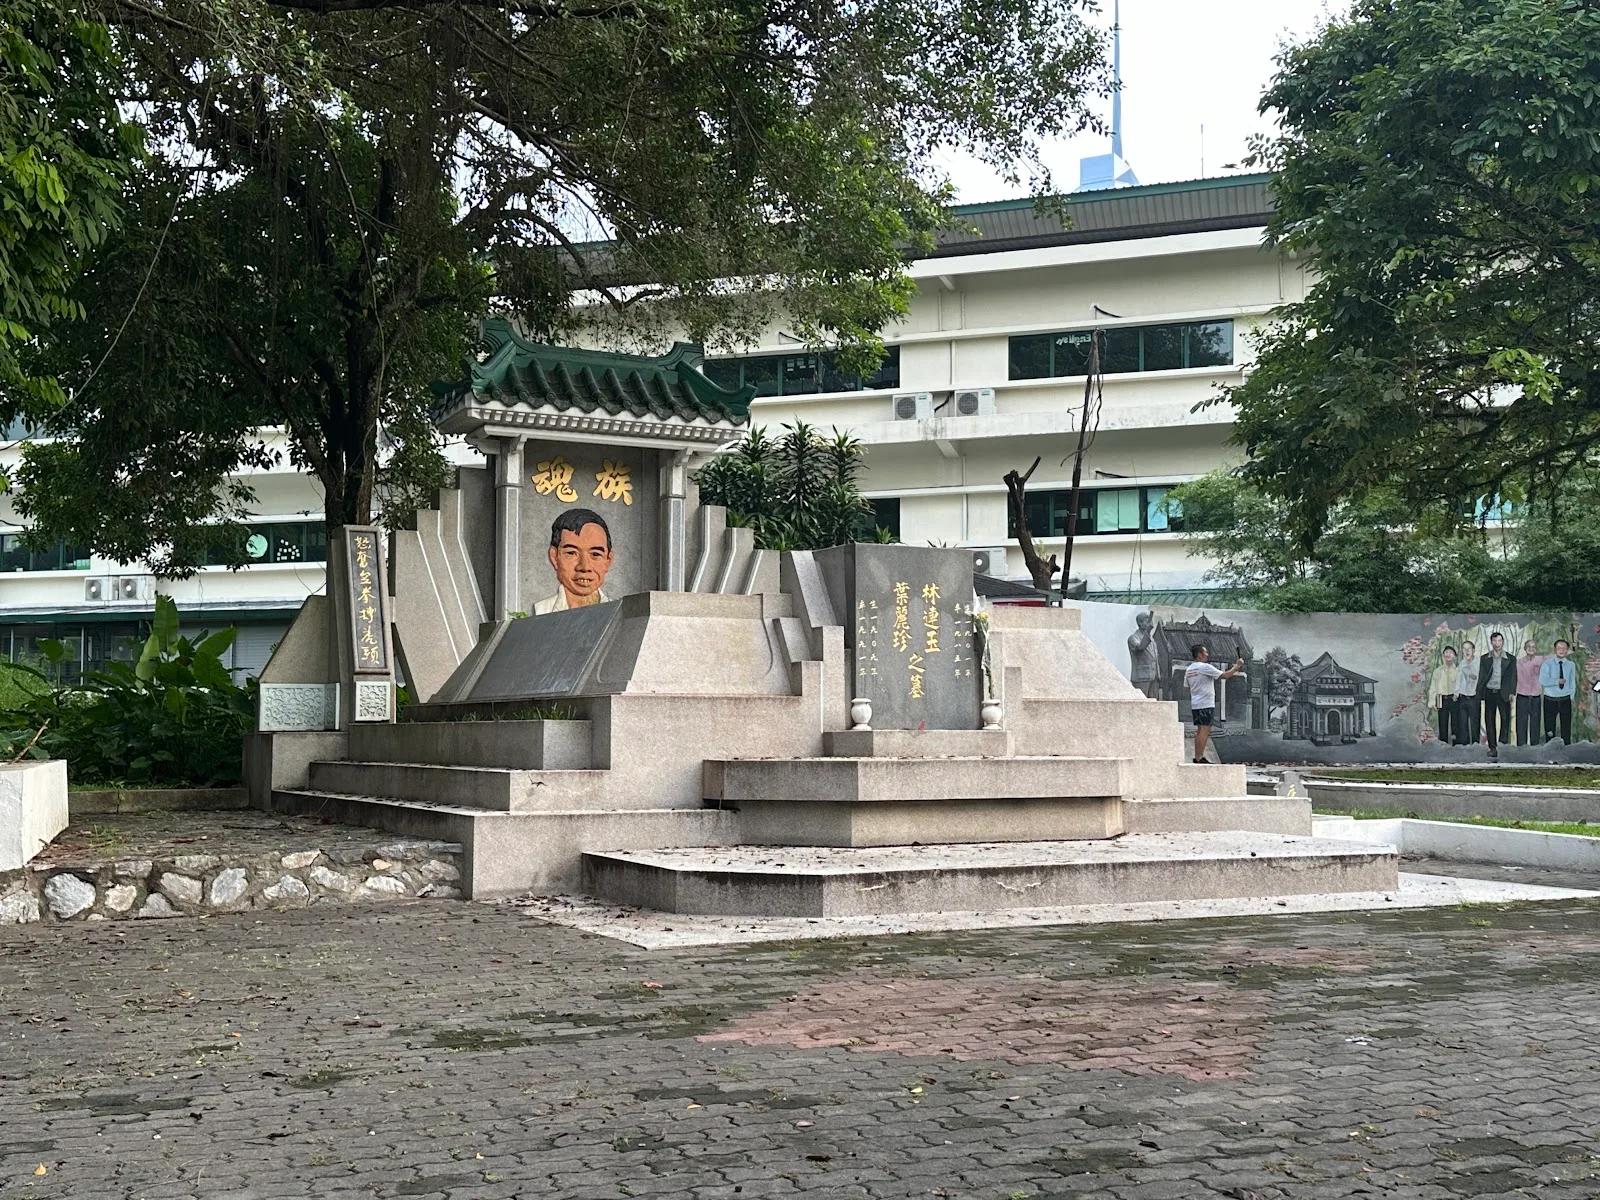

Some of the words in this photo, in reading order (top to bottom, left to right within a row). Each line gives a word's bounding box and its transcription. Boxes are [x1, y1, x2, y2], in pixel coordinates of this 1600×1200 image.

[892, 581, 913, 652] 葉麗珍
[921, 582, 942, 654] 林連玉
[908, 652, 927, 699] 之墓
